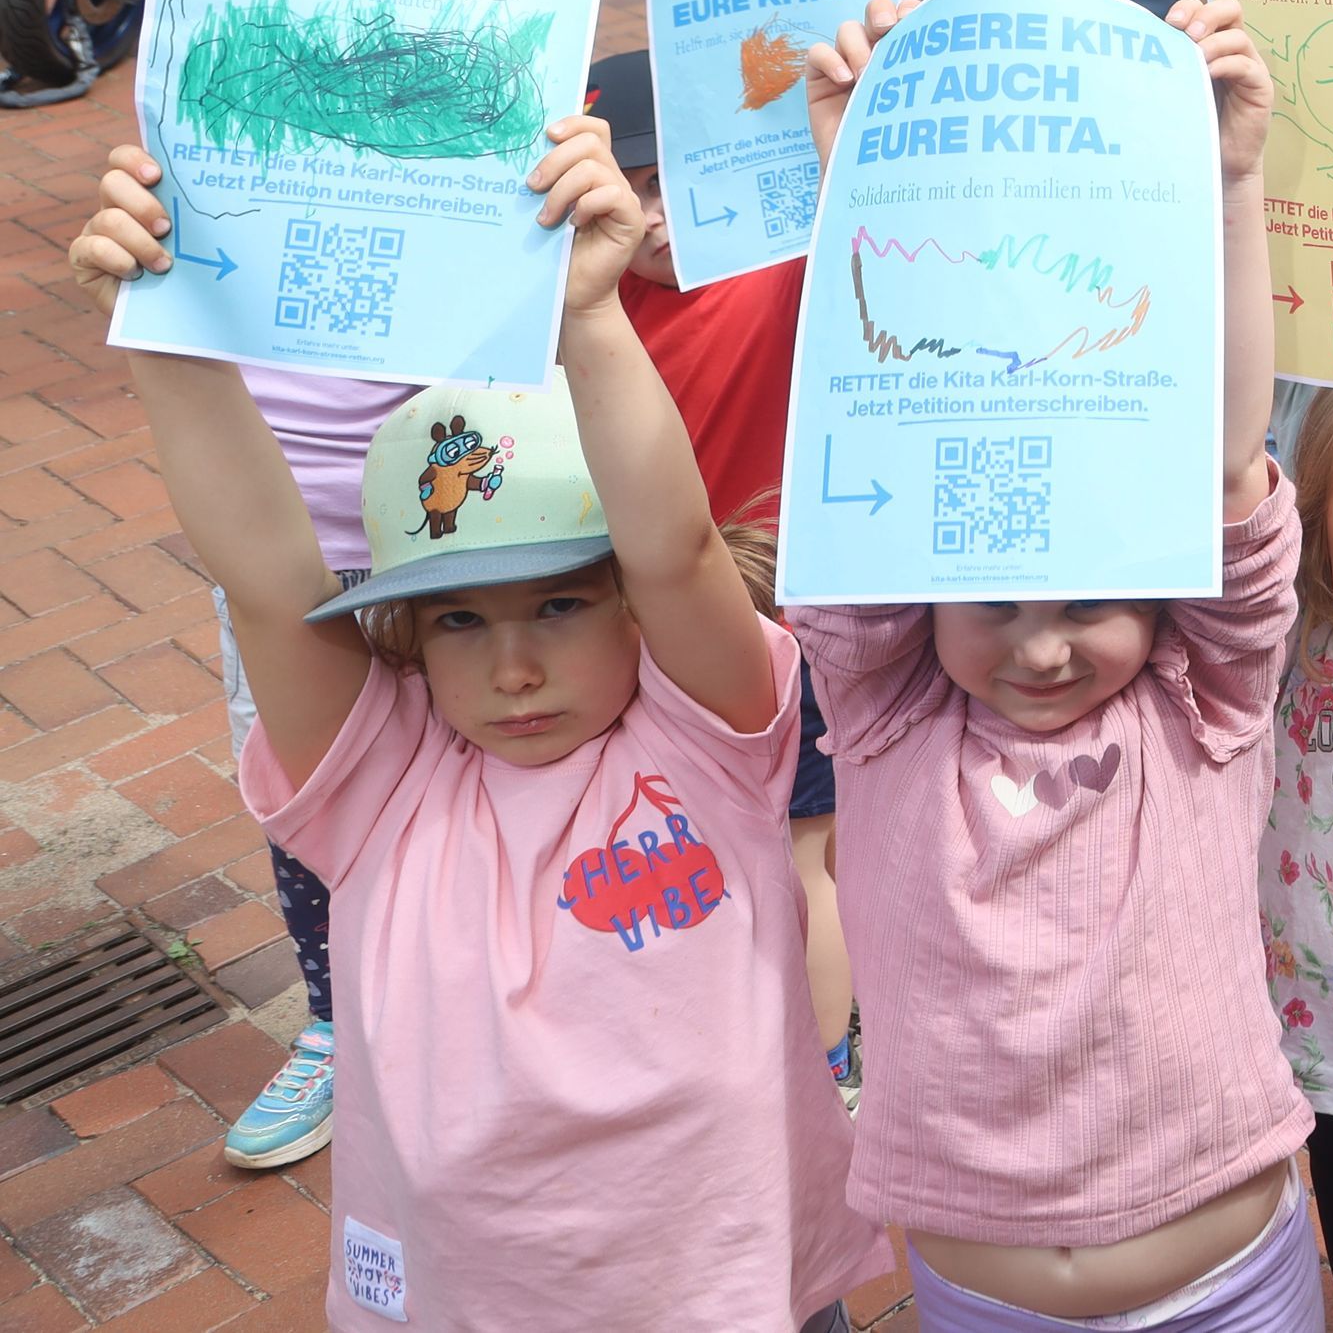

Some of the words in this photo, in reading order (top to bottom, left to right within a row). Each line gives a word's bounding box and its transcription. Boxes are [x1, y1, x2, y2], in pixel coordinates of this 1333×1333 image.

[882, 12, 1048, 70] UNSERE
[1061, 16, 1173, 69] KITA
[866, 71, 925, 117] IST
[931, 63, 1080, 105] AUCH
[856, 116, 969, 165] EURE
[982, 114, 1121, 156] KITA.
[849, 182, 921, 209] Solidarität
[928, 180, 955, 200] mit
[962, 177, 993, 199] den
[1001, 176, 1081, 200] Familien
[1089, 182, 1112, 200] im
[1121, 180, 1181, 204] Veedel.
[829, 373, 904, 394] RETTET
[908, 373, 937, 390] die
[943, 371, 984, 389] Kita
[990, 369, 1178, 389] Karl-Korn-Straße.
[846, 398, 893, 417] Jetzt
[899, 397, 974, 415] Petition
[981, 394, 1149, 414] unterschreiben.
[610, 867, 731, 952] VIBE
[346, 1239, 395, 1272] SUMMER
[357, 1264, 382, 1284] POP
[353, 1280, 389, 1306] VIBES
